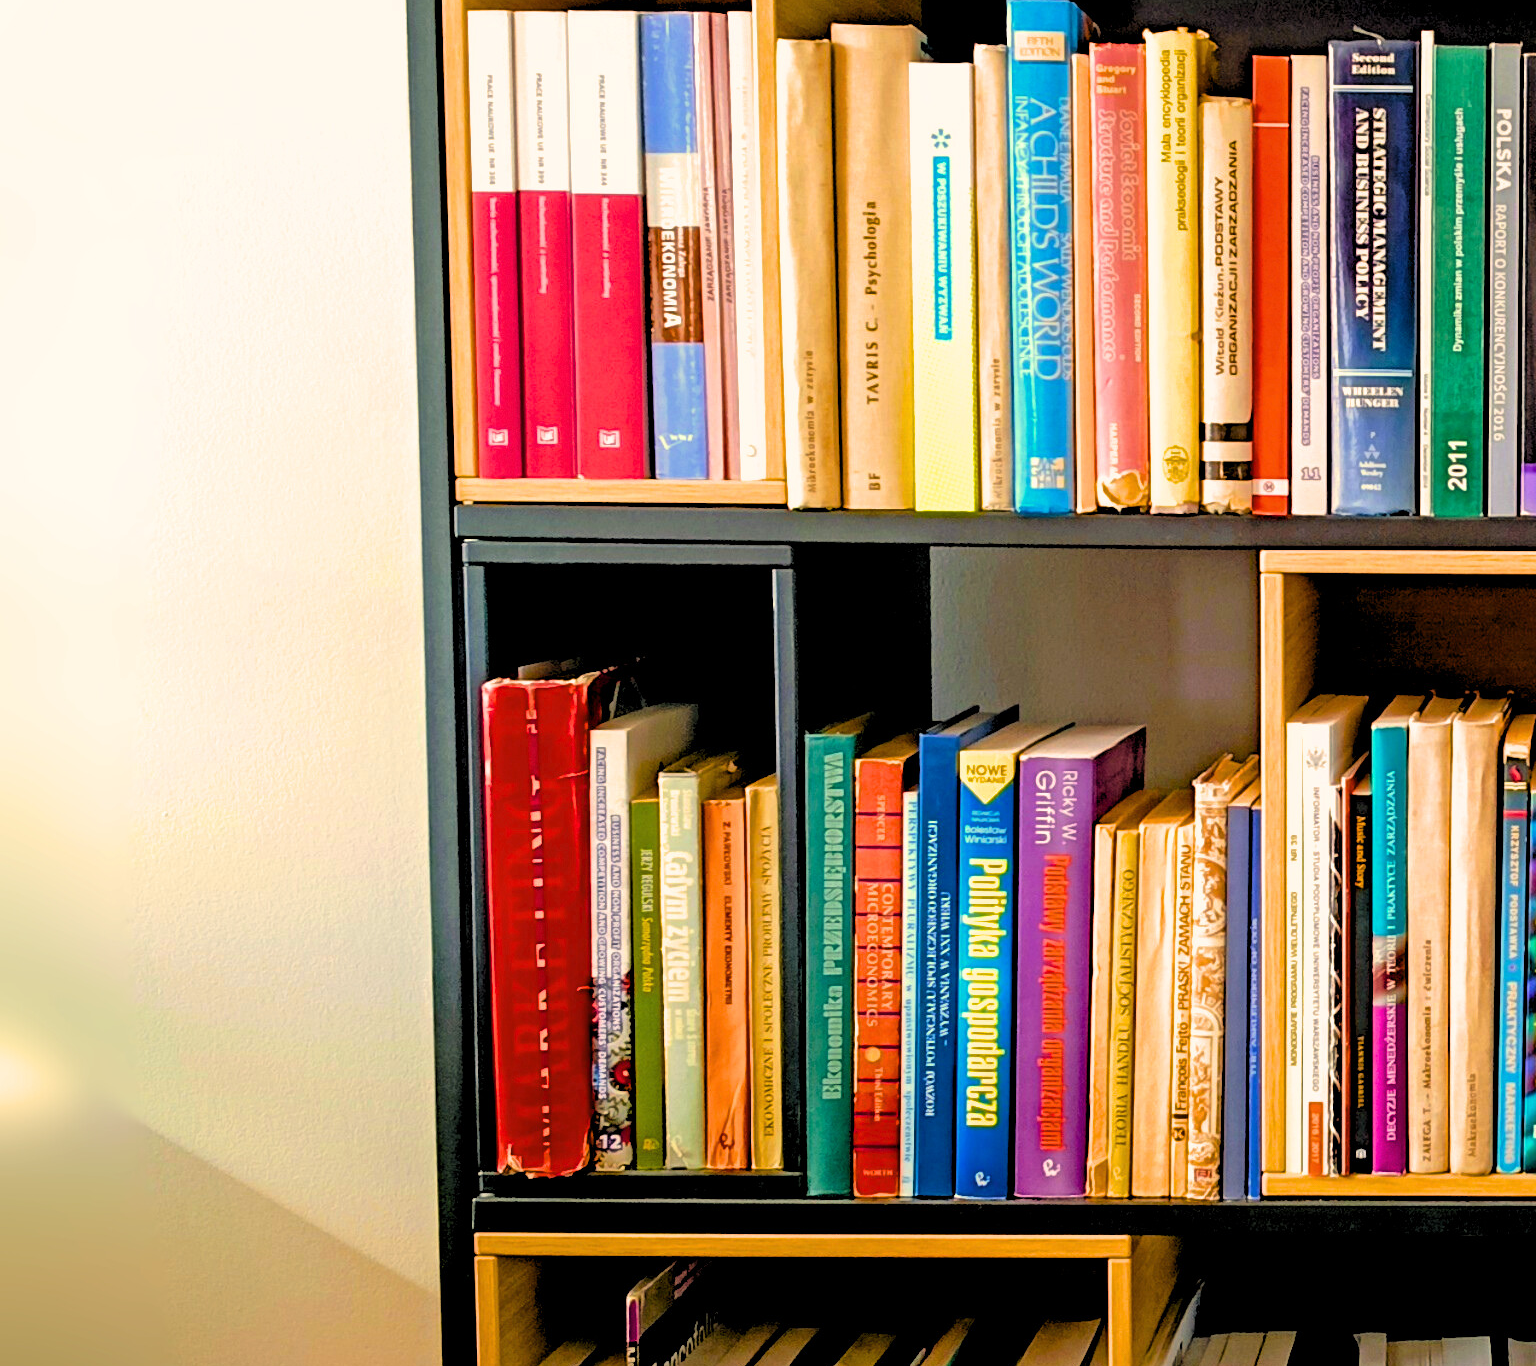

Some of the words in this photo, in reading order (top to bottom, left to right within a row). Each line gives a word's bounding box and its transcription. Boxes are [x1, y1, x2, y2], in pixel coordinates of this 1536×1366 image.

[1352, 53, 1394, 65] Second
[1352, 64, 1395, 76] Edition
[1356, 108, 1368, 149] AND
[1496, 108, 1513, 192] POLSKA
[937, 162, 946, 172] W
[1374, 108, 1386, 218] STRATEGIC
[937, 177, 949, 269] POSZUKIWANIU
[1356, 152, 1368, 247] BUSINESS
[1495, 204, 1506, 255] RAPORT
[863, 200, 880, 297] Psychologia
[1495, 259, 1506, 267] O
[937, 276, 952, 334] WYZWAŃ
[1356, 251, 1368, 321] POLICY
[1374, 219, 1386, 351] MANAGEMENT
[866, 316, 878, 332] C.
[1494, 271, 1507, 403] KONKURENCYJNOŚCI
[866, 342, 879, 404] TAVRIS
[1342, 386, 1403, 397] WHEELEN
[1345, 397, 1400, 408] HUNGER
[1494, 407, 1505, 441] 2016
[1448, 440, 1467, 491] 2011
[1034, 770, 1055, 845] Griffin
[1060, 770, 1077, 816] Ricky
[1061, 823, 1076, 844] W.
[823, 753, 846, 975] PRZEDSIĘBIORSTWA
[962, 858, 1008, 959] Polityka
[822, 985, 843, 1100] Ekonomika
[962, 968, 1004, 1127] gospodarcza
